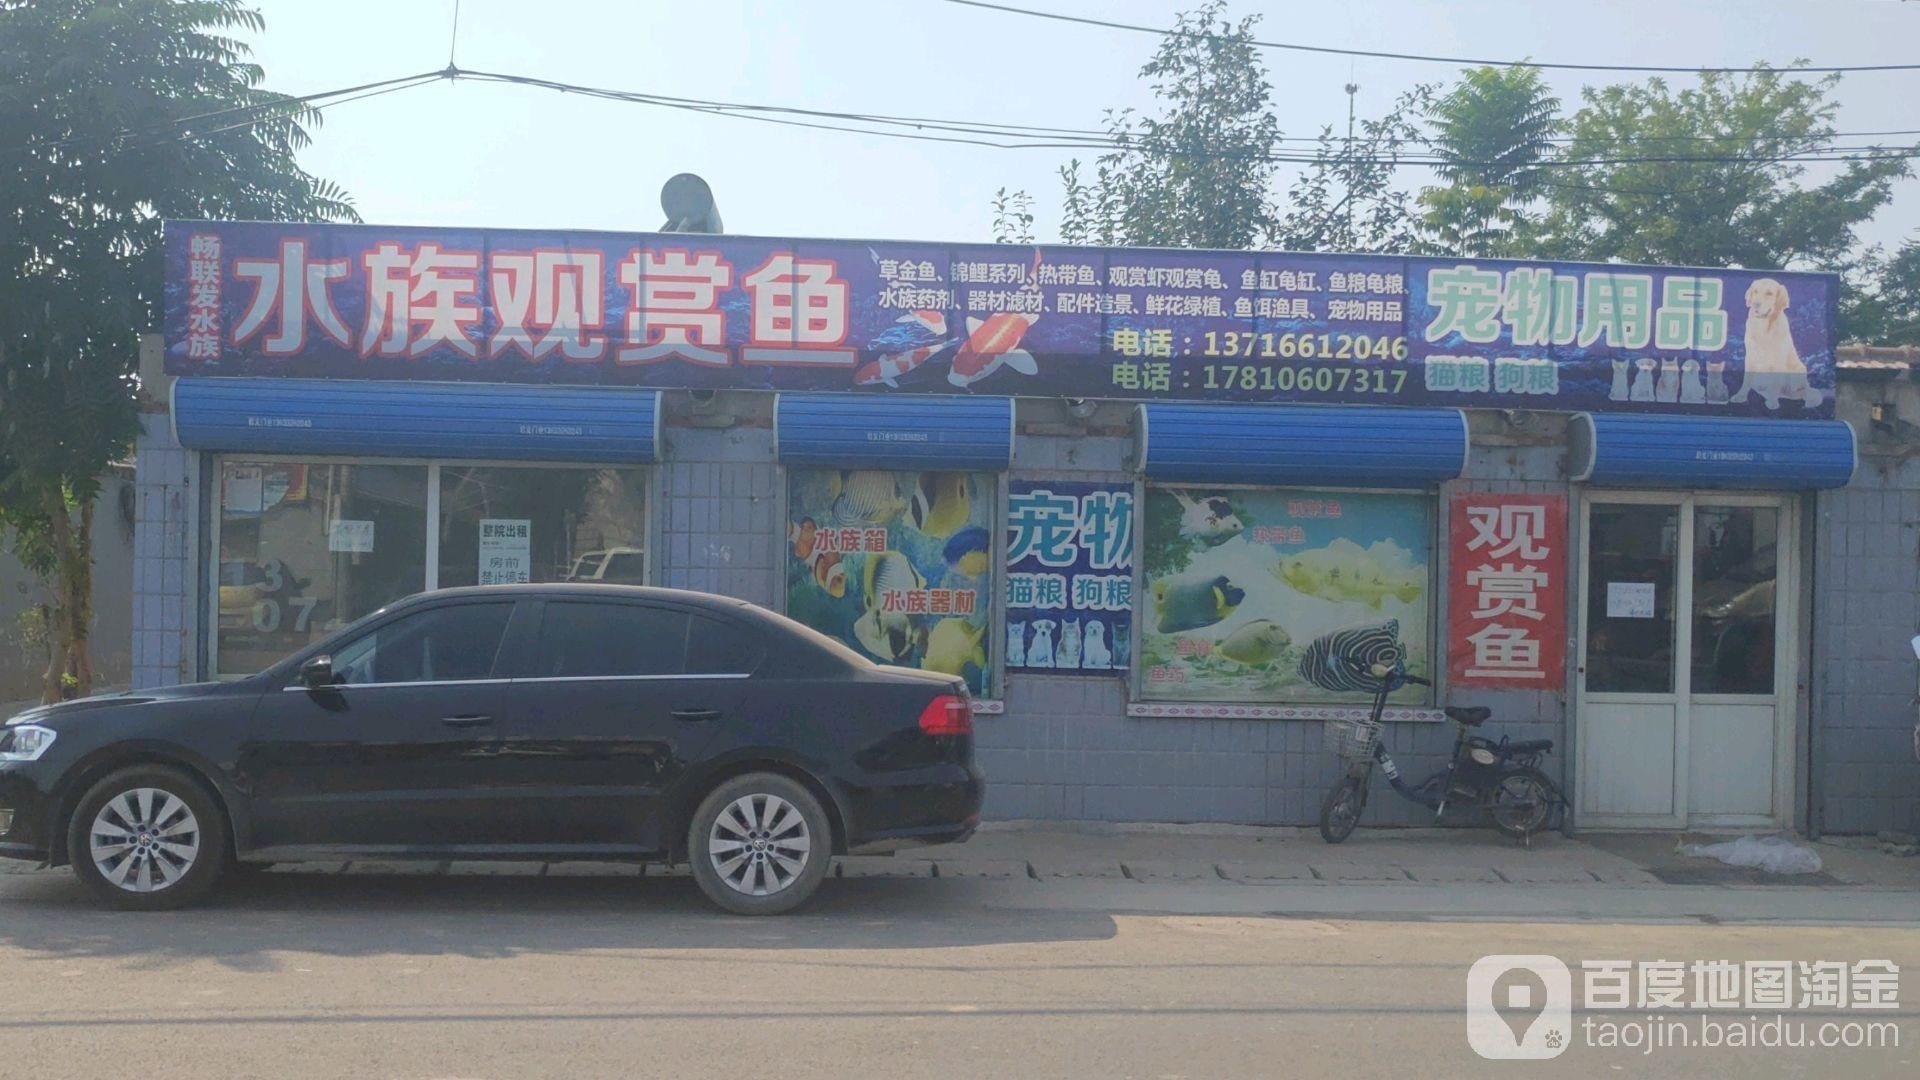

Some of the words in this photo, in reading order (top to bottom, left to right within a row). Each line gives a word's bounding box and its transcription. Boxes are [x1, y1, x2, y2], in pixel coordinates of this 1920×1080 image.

[189, 235, 220, 357] 畅联发水族
[232, 240, 859, 366] 水族观赏鱼
[1426, 265, 1728, 351] 宠物用品
[1425, 356, 1490, 394] 猫粮
[1494, 358, 1560, 395] 狗粮
[814, 528, 888, 553] 水族箱
[1008, 490, 1133, 569] 宠物
[882, 588, 977, 615] 水族器材
[1008, 573, 1067, 609] 猫粮
[1073, 575, 1132, 611] 狗粮
[1465, 504, 1550, 678] 观赏鱼
